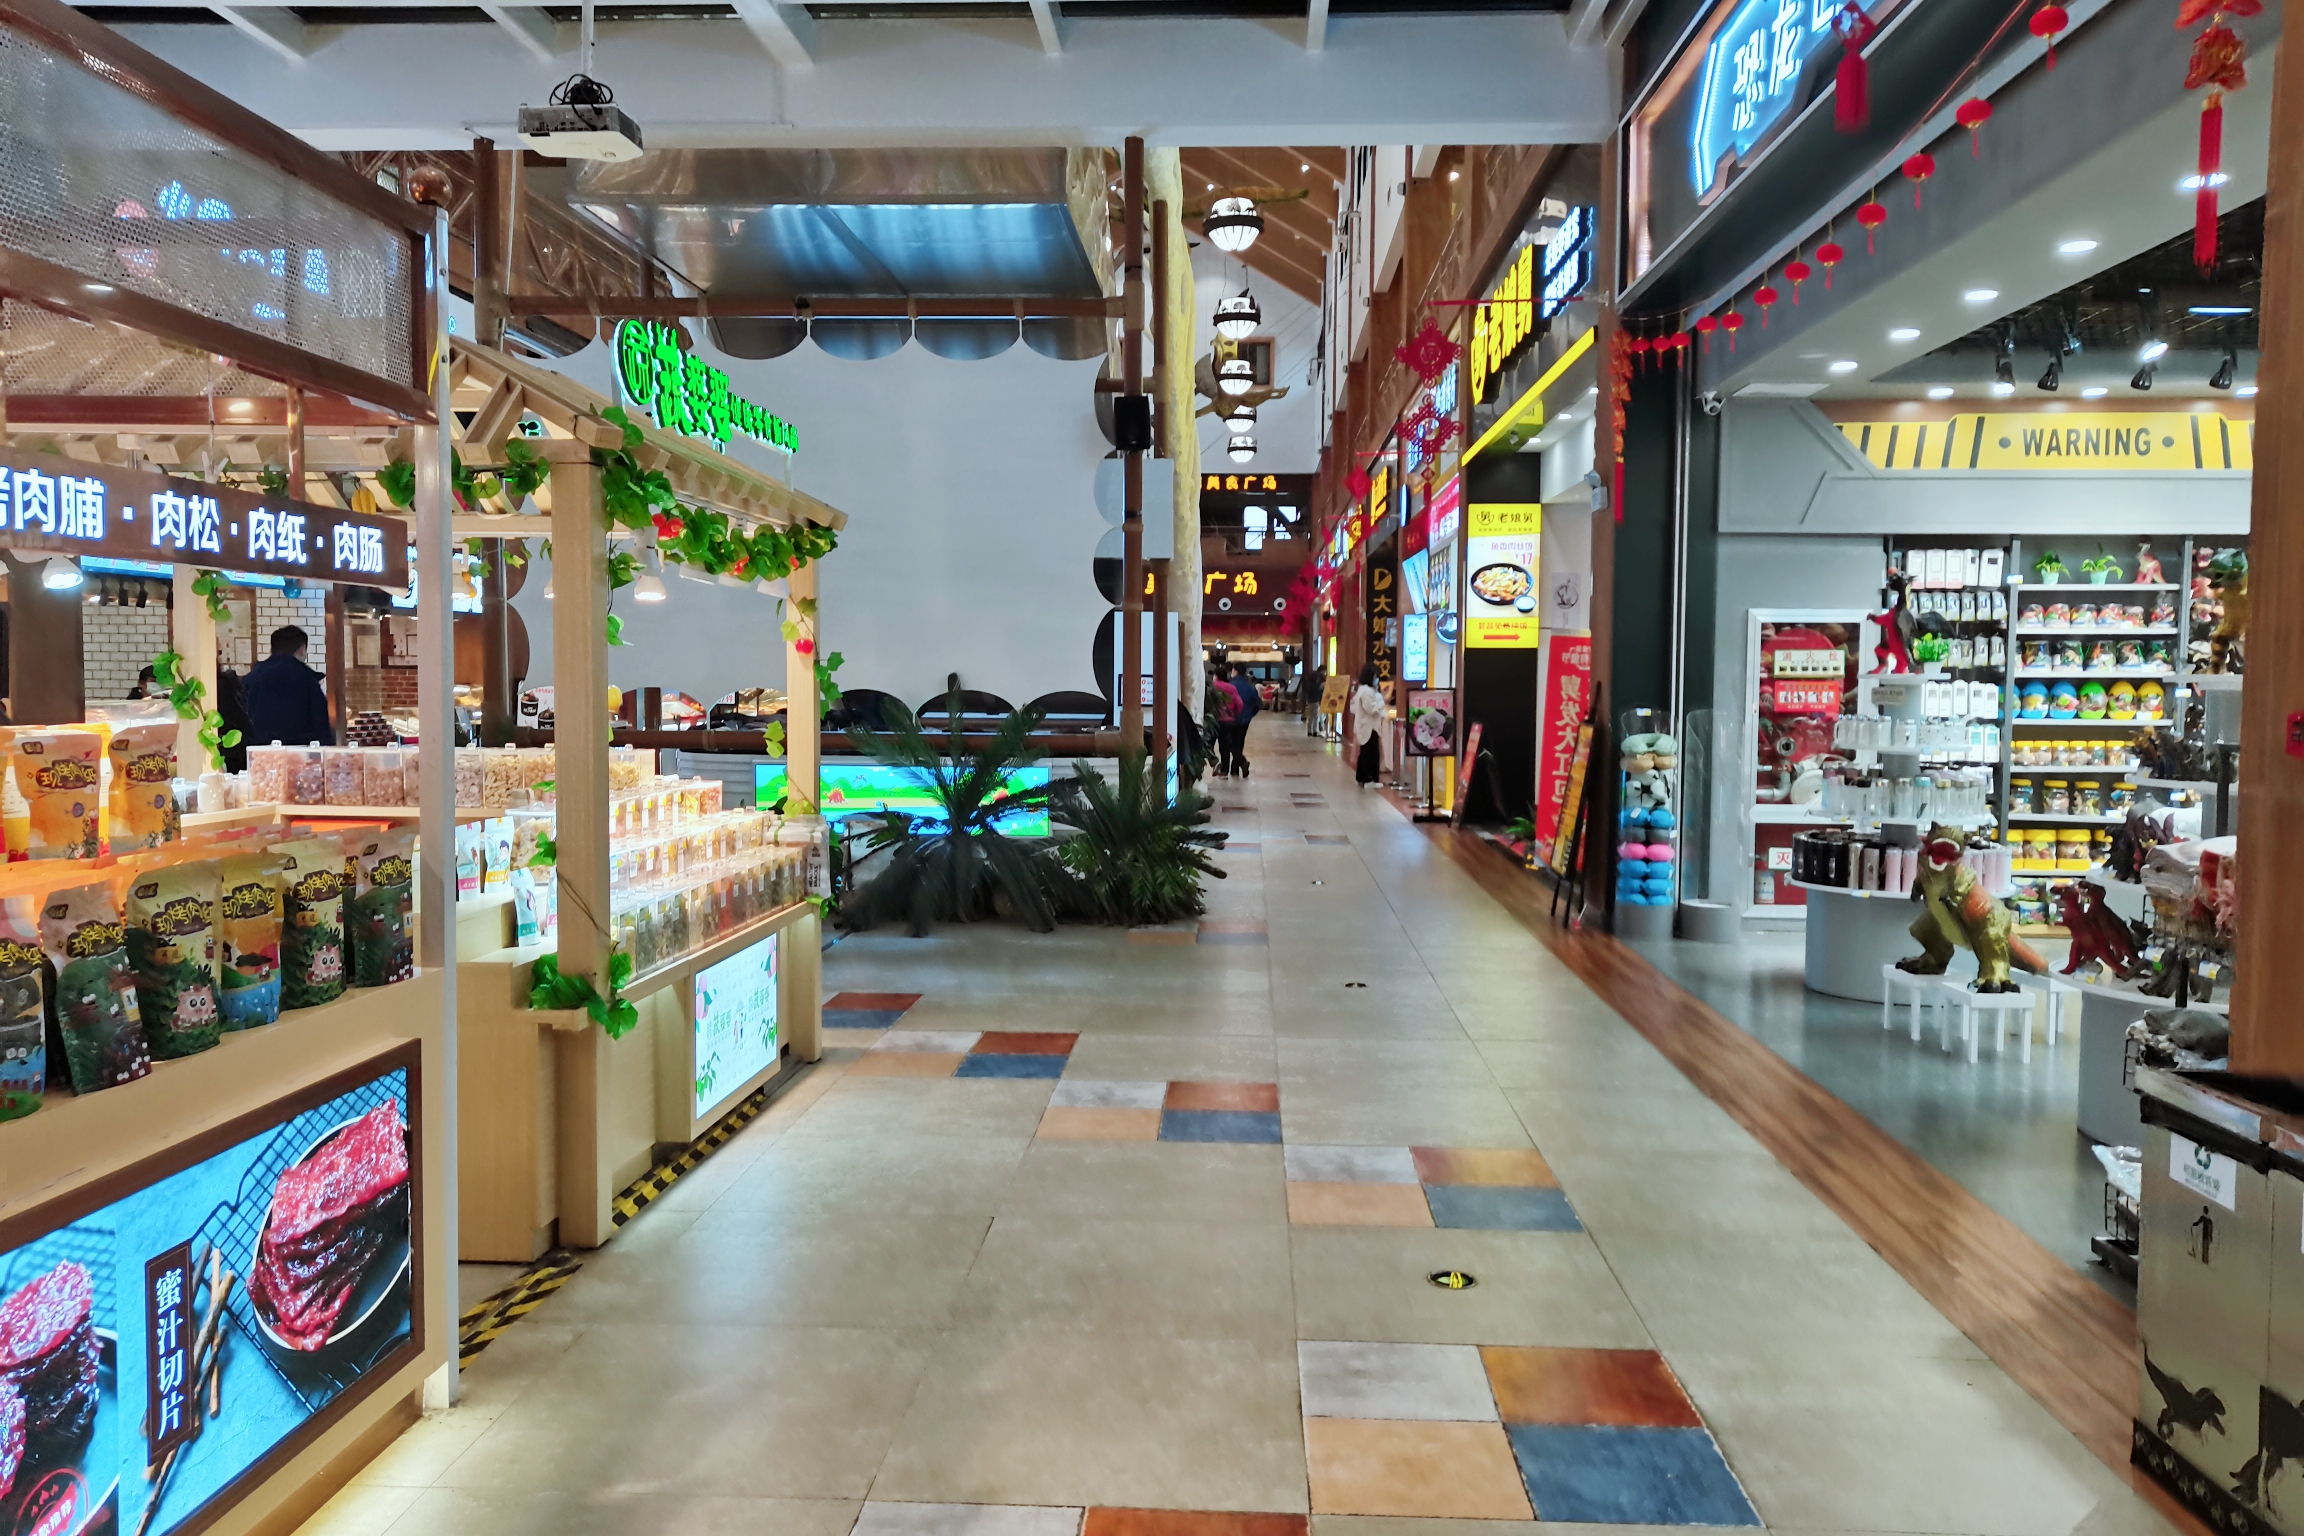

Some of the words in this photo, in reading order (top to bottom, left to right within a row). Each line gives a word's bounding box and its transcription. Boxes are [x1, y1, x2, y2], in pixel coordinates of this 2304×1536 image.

[2022, 427, 2151, 457] WARNING
[1200, 475, 1277, 490] 美食广场
[1782, 650, 1839, 661] 消火栓
[1776, 851, 1791, 865] 灭
[156, 1267, 185, 1441] 蜜汁切片
